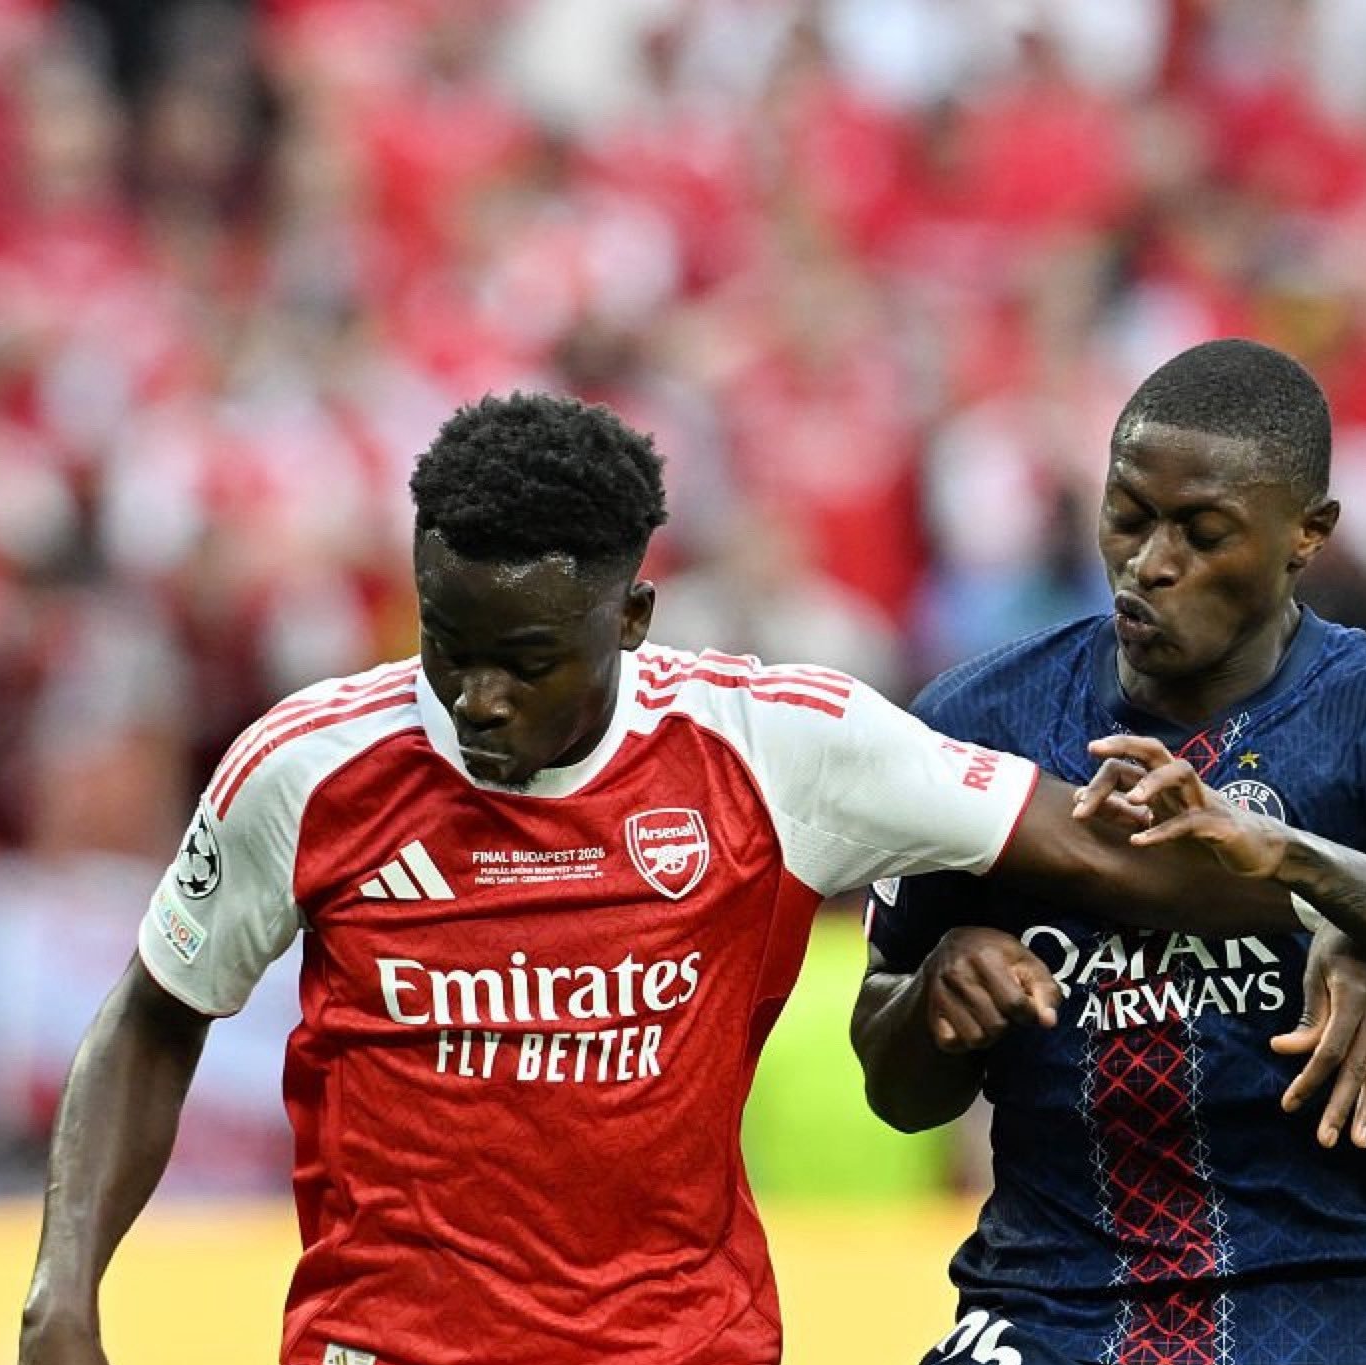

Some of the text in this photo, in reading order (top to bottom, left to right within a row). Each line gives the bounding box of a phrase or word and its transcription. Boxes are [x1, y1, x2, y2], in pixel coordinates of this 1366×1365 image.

[472, 851, 510, 864] FINAL
[512, 849, 576, 863] BUDAPEST
[638, 821, 698, 841] Arsenal
[375, 951, 702, 1025] Emirates
[1076, 971, 1285, 1031] AIRWAYS
[436, 1024, 662, 1083] FLY BETTER
